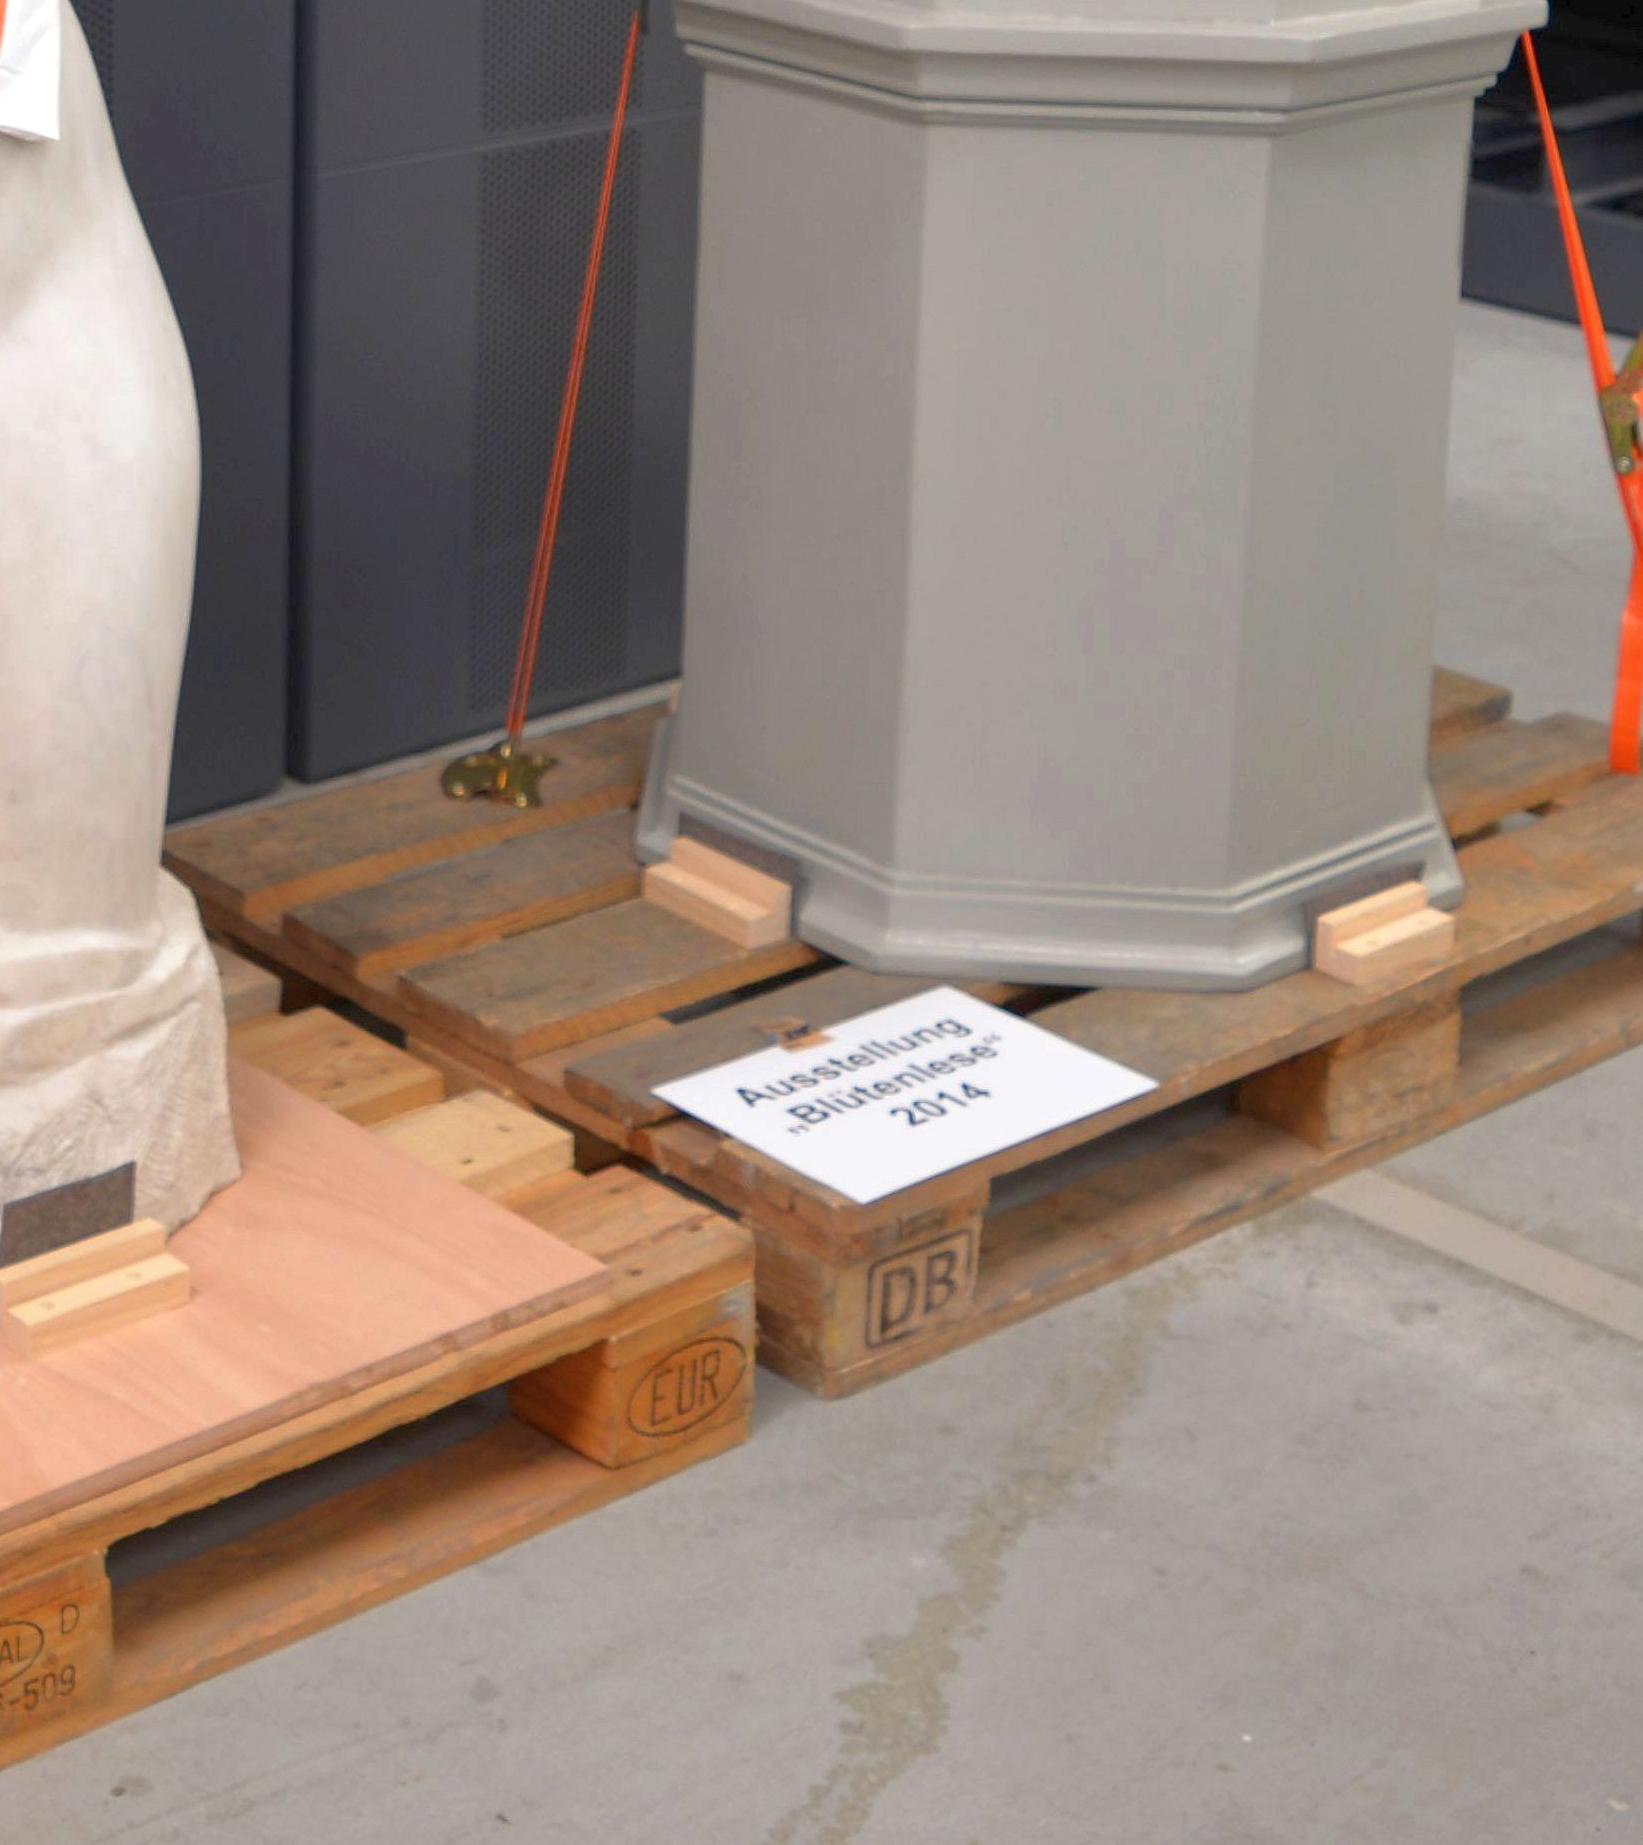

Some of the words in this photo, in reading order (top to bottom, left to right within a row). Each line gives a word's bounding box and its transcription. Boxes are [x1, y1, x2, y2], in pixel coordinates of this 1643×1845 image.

[735, 1019, 972, 1107] Ausstellung
[889, 1082, 992, 1127] 2014
[880, 1250, 956, 1334] DB
[651, 1349, 720, 1427] EUR
